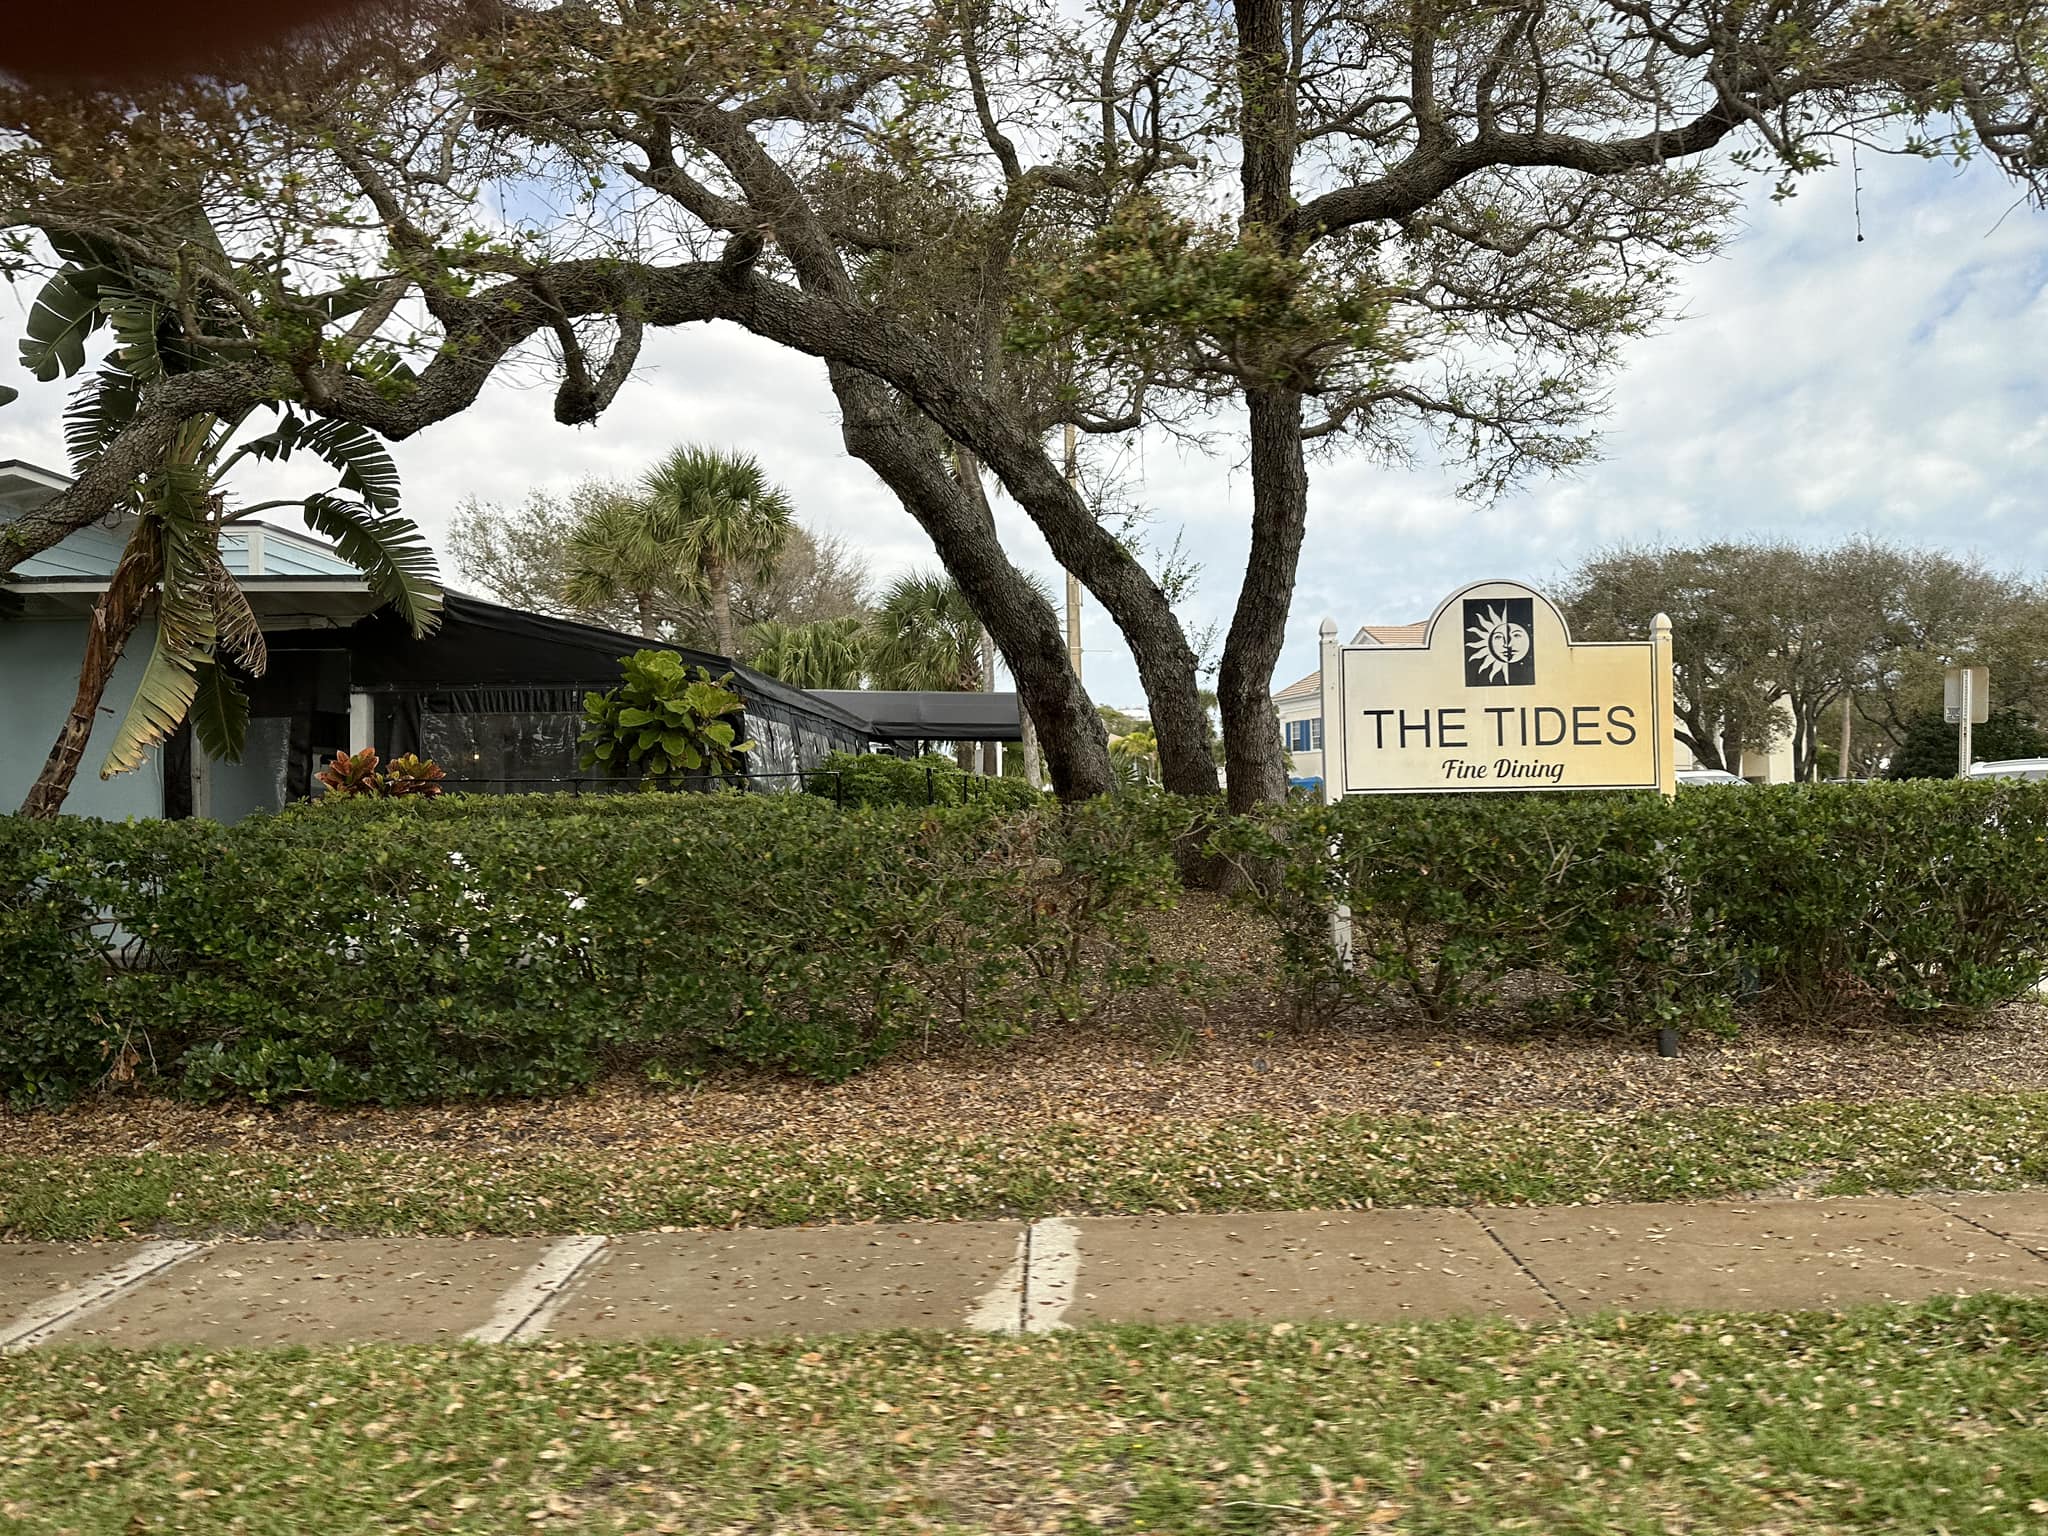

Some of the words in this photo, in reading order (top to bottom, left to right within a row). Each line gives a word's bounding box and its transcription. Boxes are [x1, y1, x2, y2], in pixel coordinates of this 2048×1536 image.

[1363, 708, 1468, 749] THE
[1484, 705, 1637, 747] TIDES
[1441, 759, 1488, 779] Fine
[1493, 758, 1565, 783] Dining
